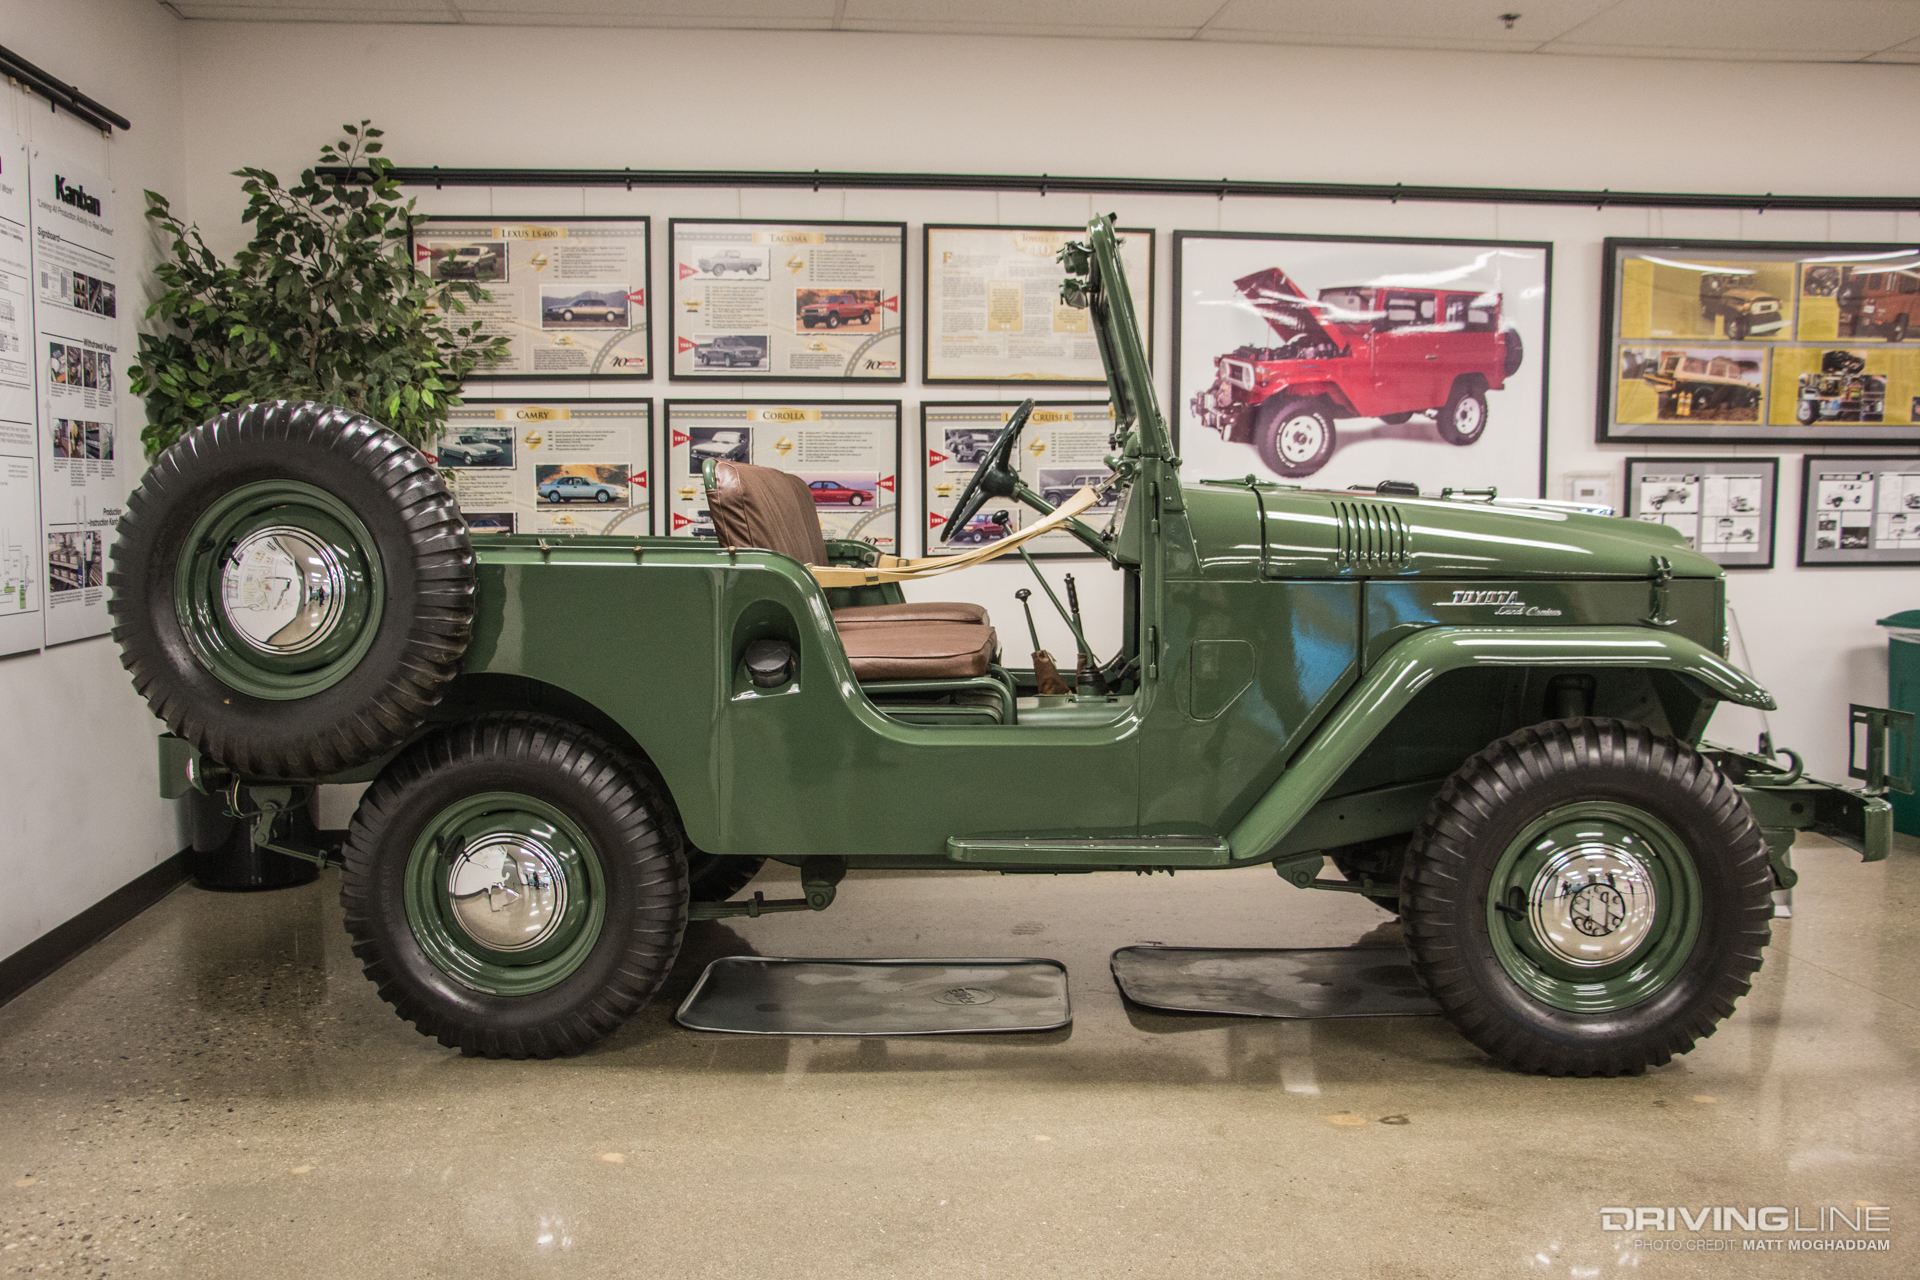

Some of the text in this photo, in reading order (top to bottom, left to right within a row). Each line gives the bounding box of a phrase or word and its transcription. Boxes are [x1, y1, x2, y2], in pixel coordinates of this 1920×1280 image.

[55, 174, 101, 217] Kanban
[502, 229, 529, 238] LEXUS
[769, 234, 808, 243] TACOMA
[516, 410, 549, 419] CAMRY
[762, 411, 805, 420] COROLLA
[1032, 412, 1070, 421] CRUISER
[1452, 590, 1519, 604] TOYOTA
